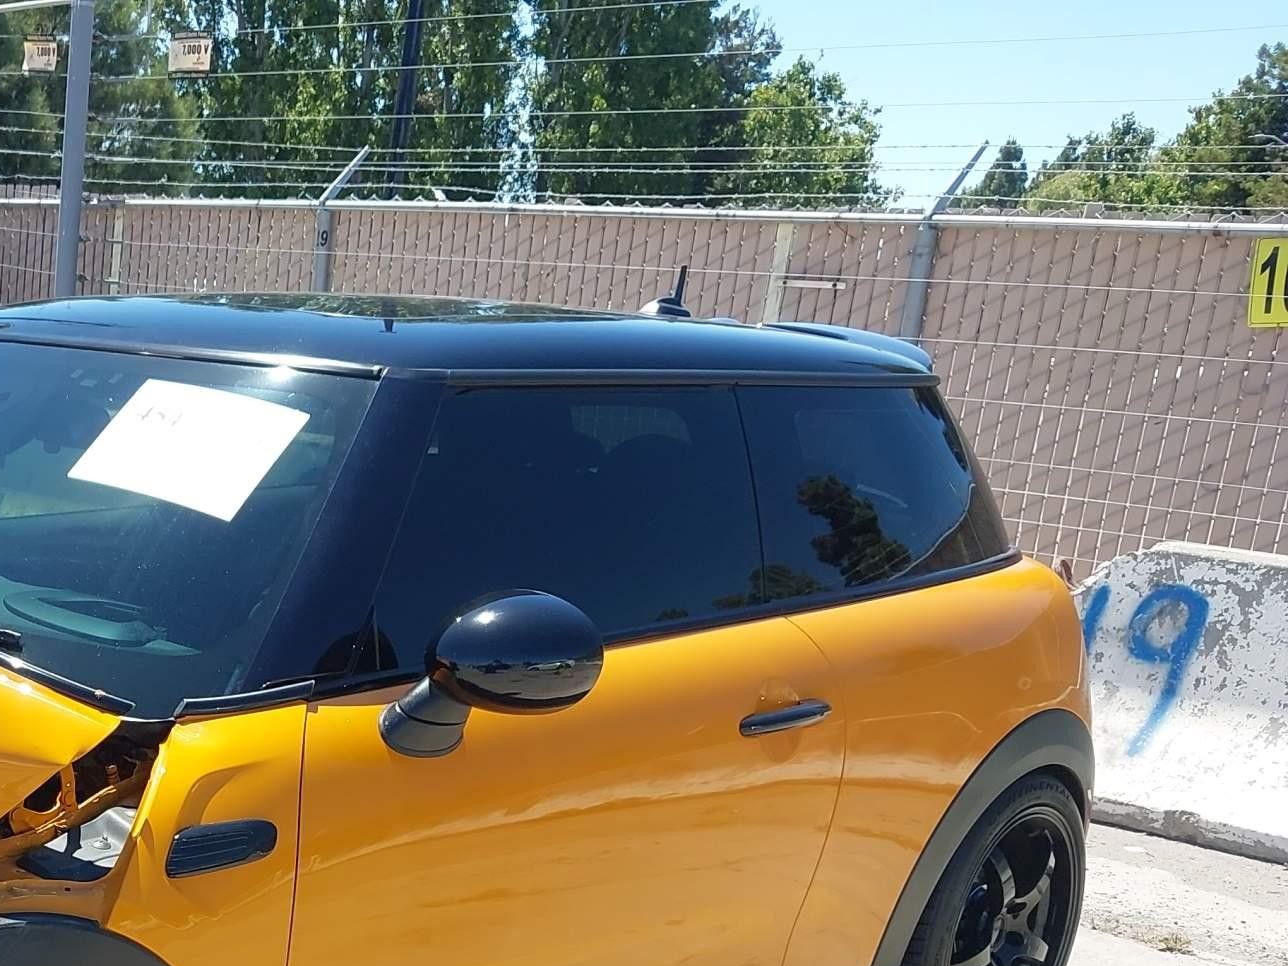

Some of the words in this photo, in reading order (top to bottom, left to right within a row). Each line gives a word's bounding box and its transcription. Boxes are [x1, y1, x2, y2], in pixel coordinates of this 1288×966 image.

[182, 44, 202, 57] 7,000
[204, 44, 209, 55] V
[1259, 246, 1288, 314] 1
